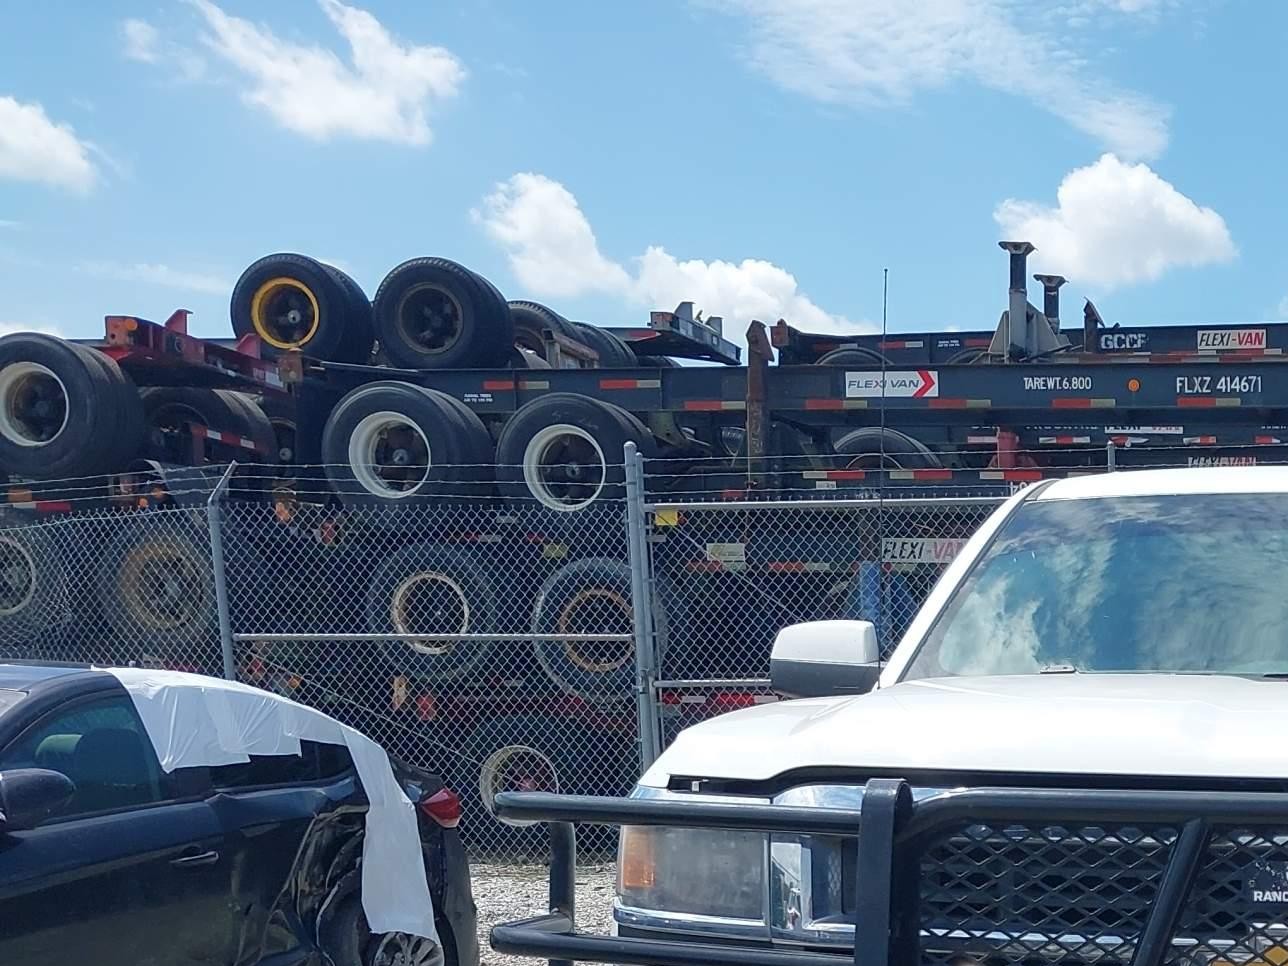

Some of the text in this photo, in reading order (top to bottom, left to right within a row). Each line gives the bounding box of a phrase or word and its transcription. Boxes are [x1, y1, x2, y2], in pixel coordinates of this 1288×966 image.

[1199, 332, 1265, 347] FLEXI-VAN
[847, 379, 920, 389] FLEXI VAN
[1176, 375, 1262, 393] FLXZ 414671
